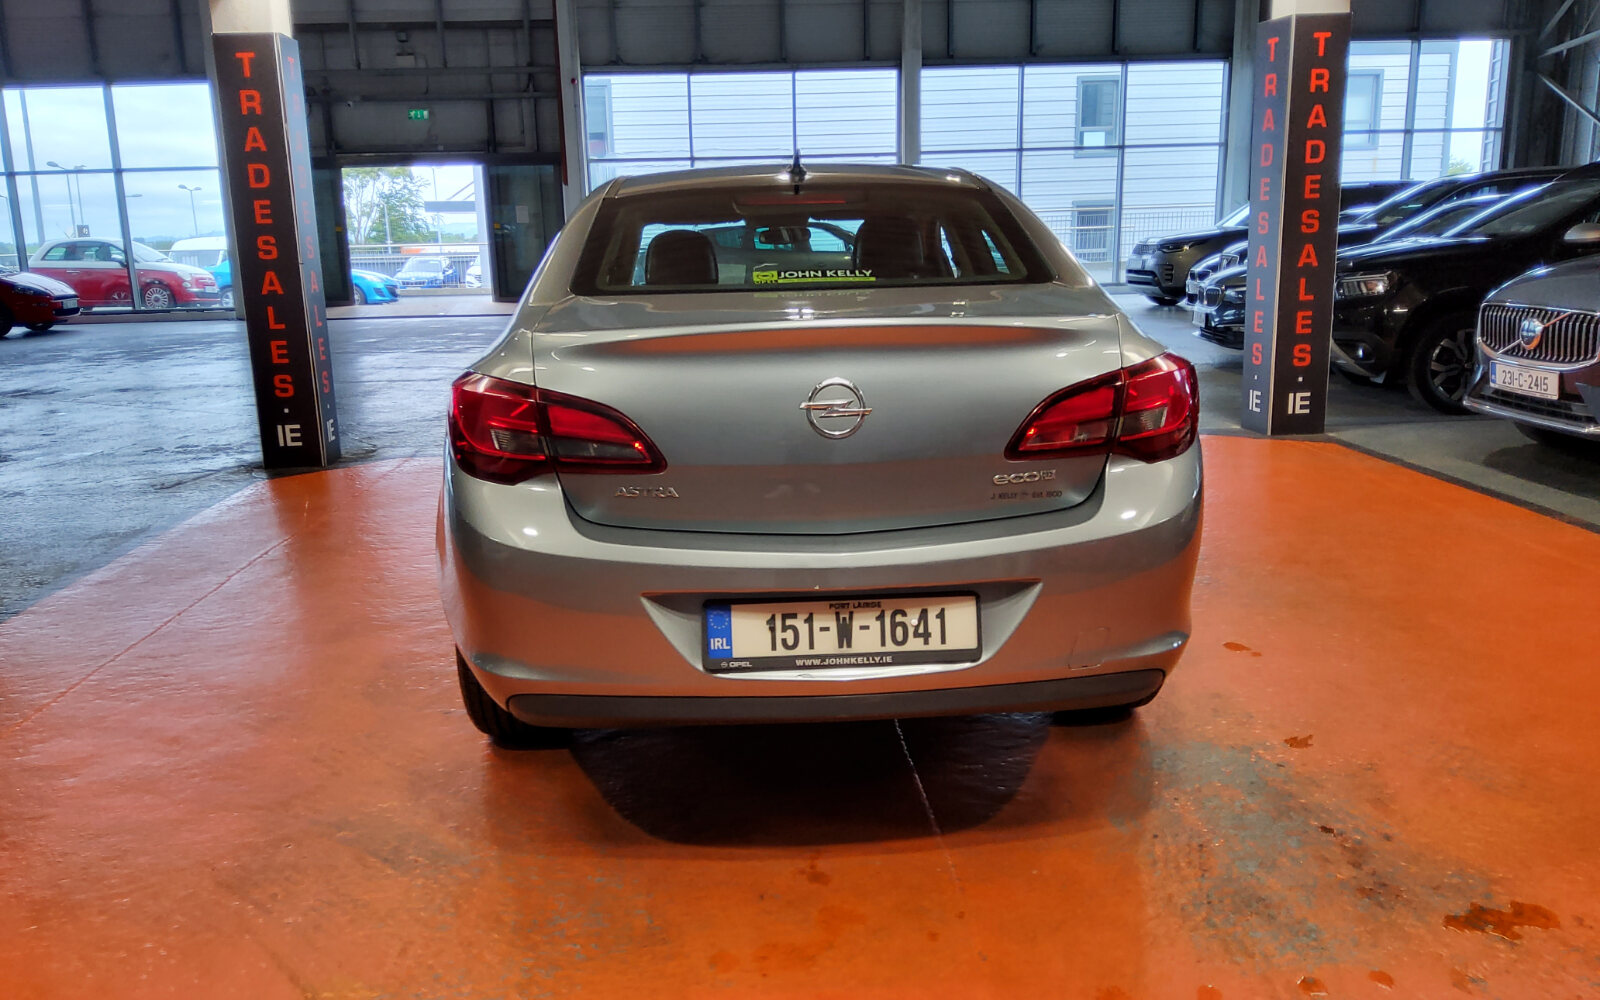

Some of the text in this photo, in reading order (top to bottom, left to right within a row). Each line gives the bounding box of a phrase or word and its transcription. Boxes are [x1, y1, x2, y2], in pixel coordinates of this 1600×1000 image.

[779, 269, 873, 279] JOHN KELLY
[1502, 370, 1549, 392] 231-C-2415
[615, 486, 680, 498] ASTRA
[766, 608, 947, 652] 151-W-1641
[710, 637, 731, 650] IRL
[795, 655, 893, 667] WWW.JOHNKELLY.IE
